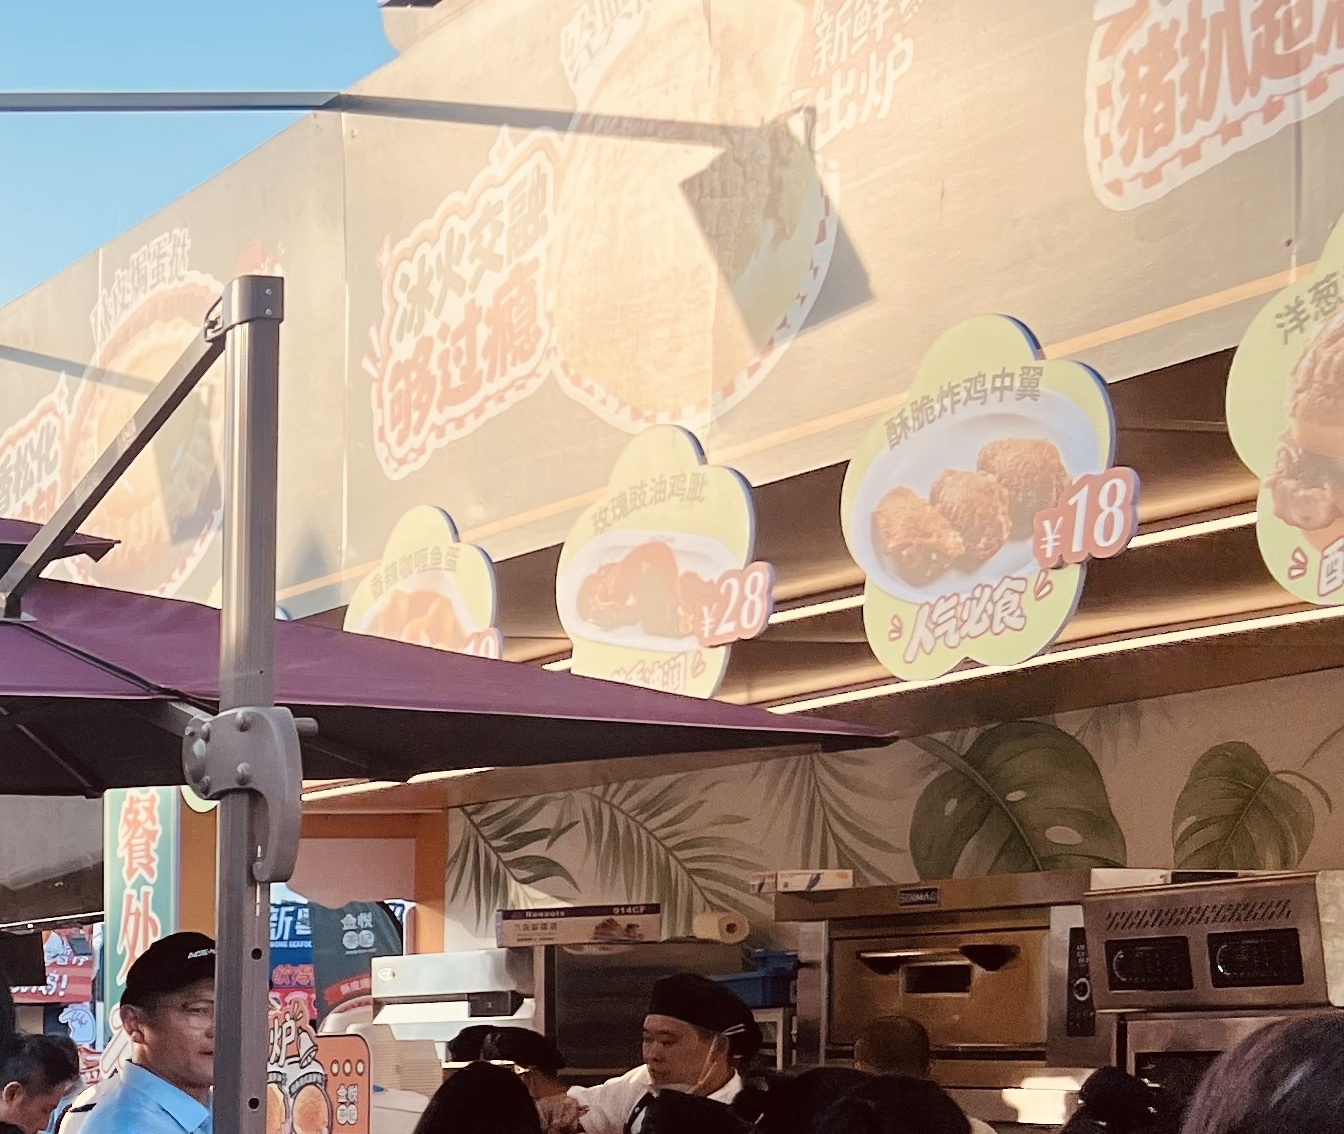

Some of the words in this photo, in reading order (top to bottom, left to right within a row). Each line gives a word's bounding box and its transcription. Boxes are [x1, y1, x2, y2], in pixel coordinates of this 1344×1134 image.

[395, 161, 549, 342] 冰火交融
[1275, 270, 1344, 345] 洋葱
[385, 263, 544, 443] 够过瘾
[884, 366, 1045, 449] 酥脆炸鸡中翼
[1039, 477, 1128, 559] ¥18
[370, 546, 461, 600] 香辣咖喱鱼蛋
[701, 571, 764, 639] ¥28
[903, 576, 1028, 664] 人气必食
